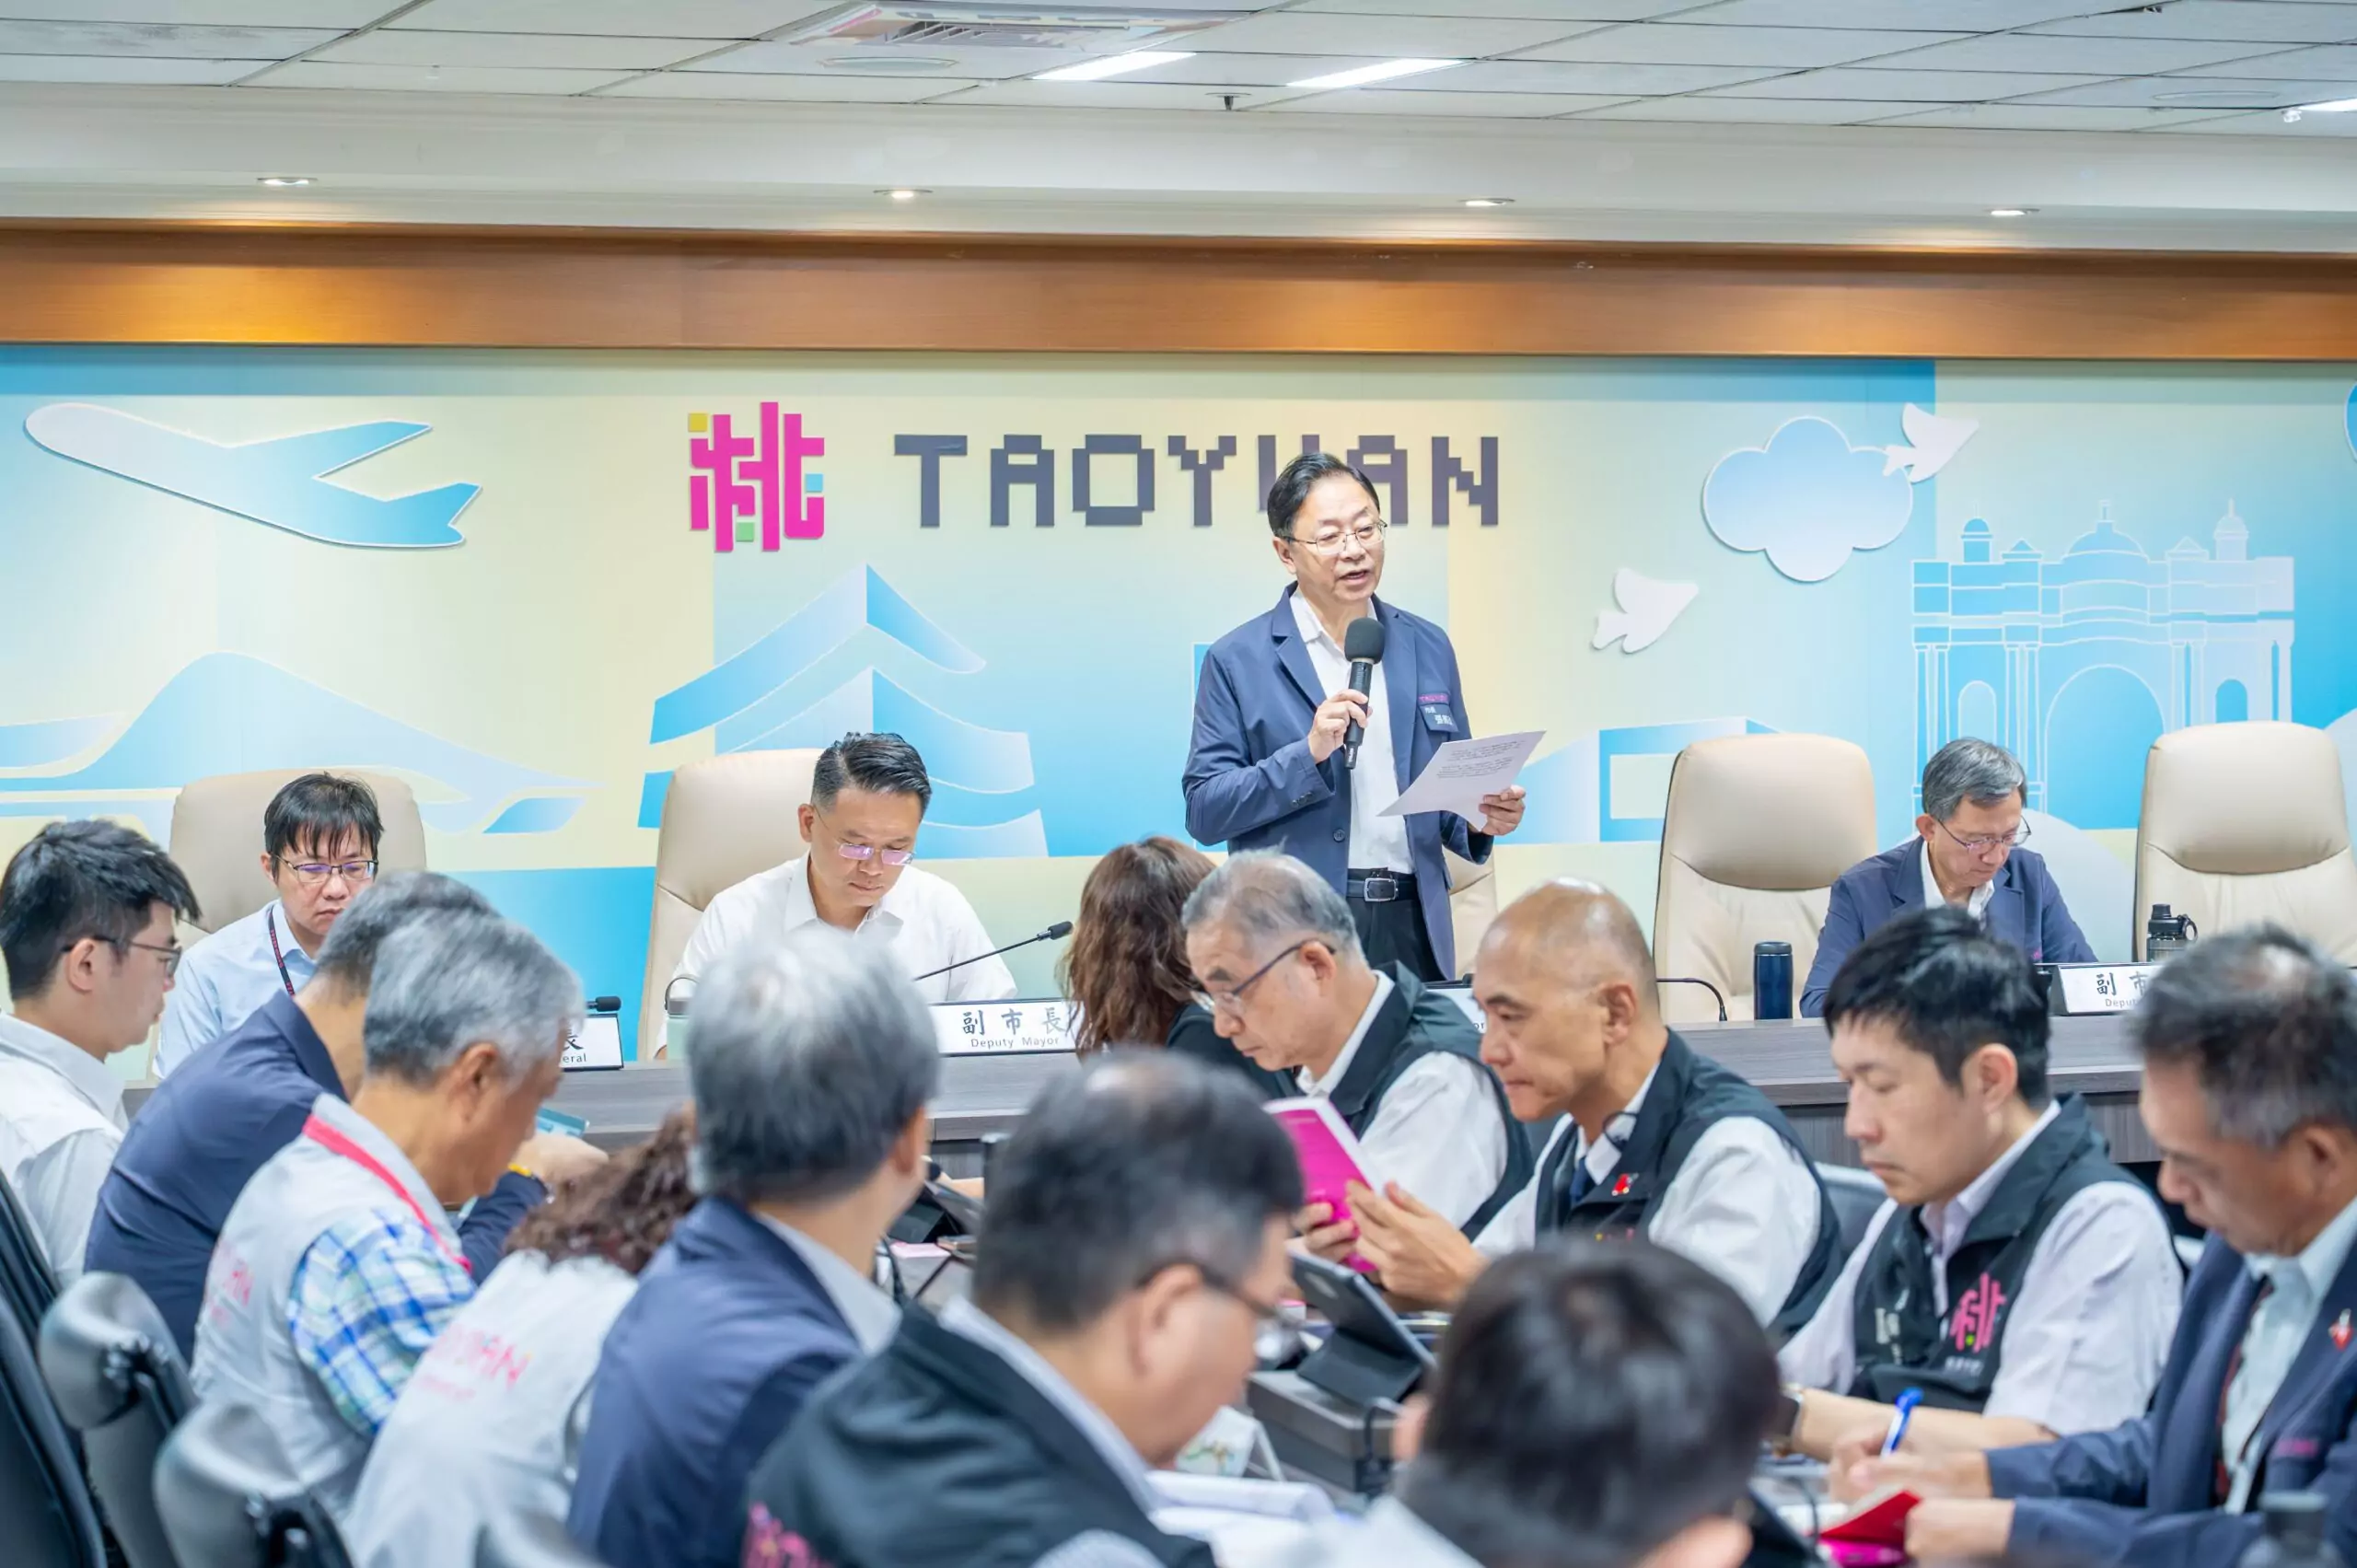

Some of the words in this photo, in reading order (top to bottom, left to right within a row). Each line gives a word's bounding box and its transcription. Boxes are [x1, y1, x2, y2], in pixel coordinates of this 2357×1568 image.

[2096, 970, 2149, 997] 副市
[2105, 997, 2137, 1008] Deput
[962, 1006, 1066, 1036] 副市長
[970, 1037, 1014, 1050] Deputy
[1021, 1036, 1060, 1048] Mayor
[562, 1052, 586, 1063] eral
